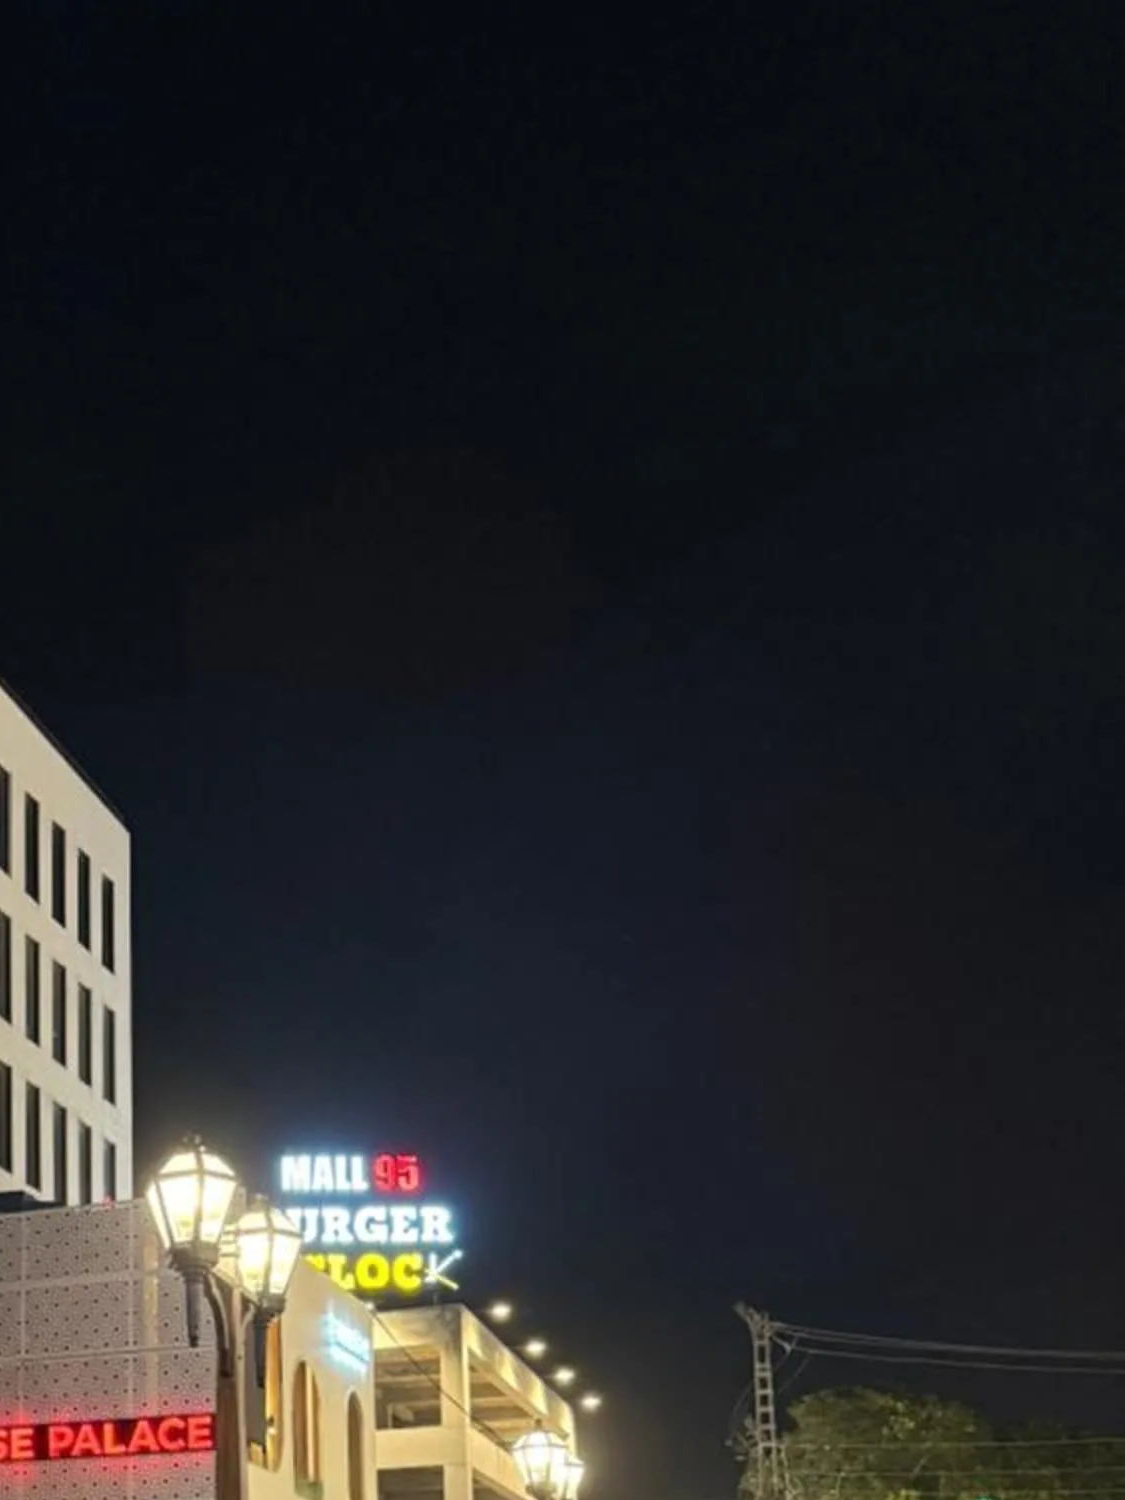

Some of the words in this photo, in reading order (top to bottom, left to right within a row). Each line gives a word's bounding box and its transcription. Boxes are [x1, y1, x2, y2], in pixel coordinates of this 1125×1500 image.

[281, 1154, 369, 1192] MALL
[374, 1154, 421, 1191] 95
[286, 1205, 455, 1243] URGER
[48, 1415, 213, 1458] PALACE
